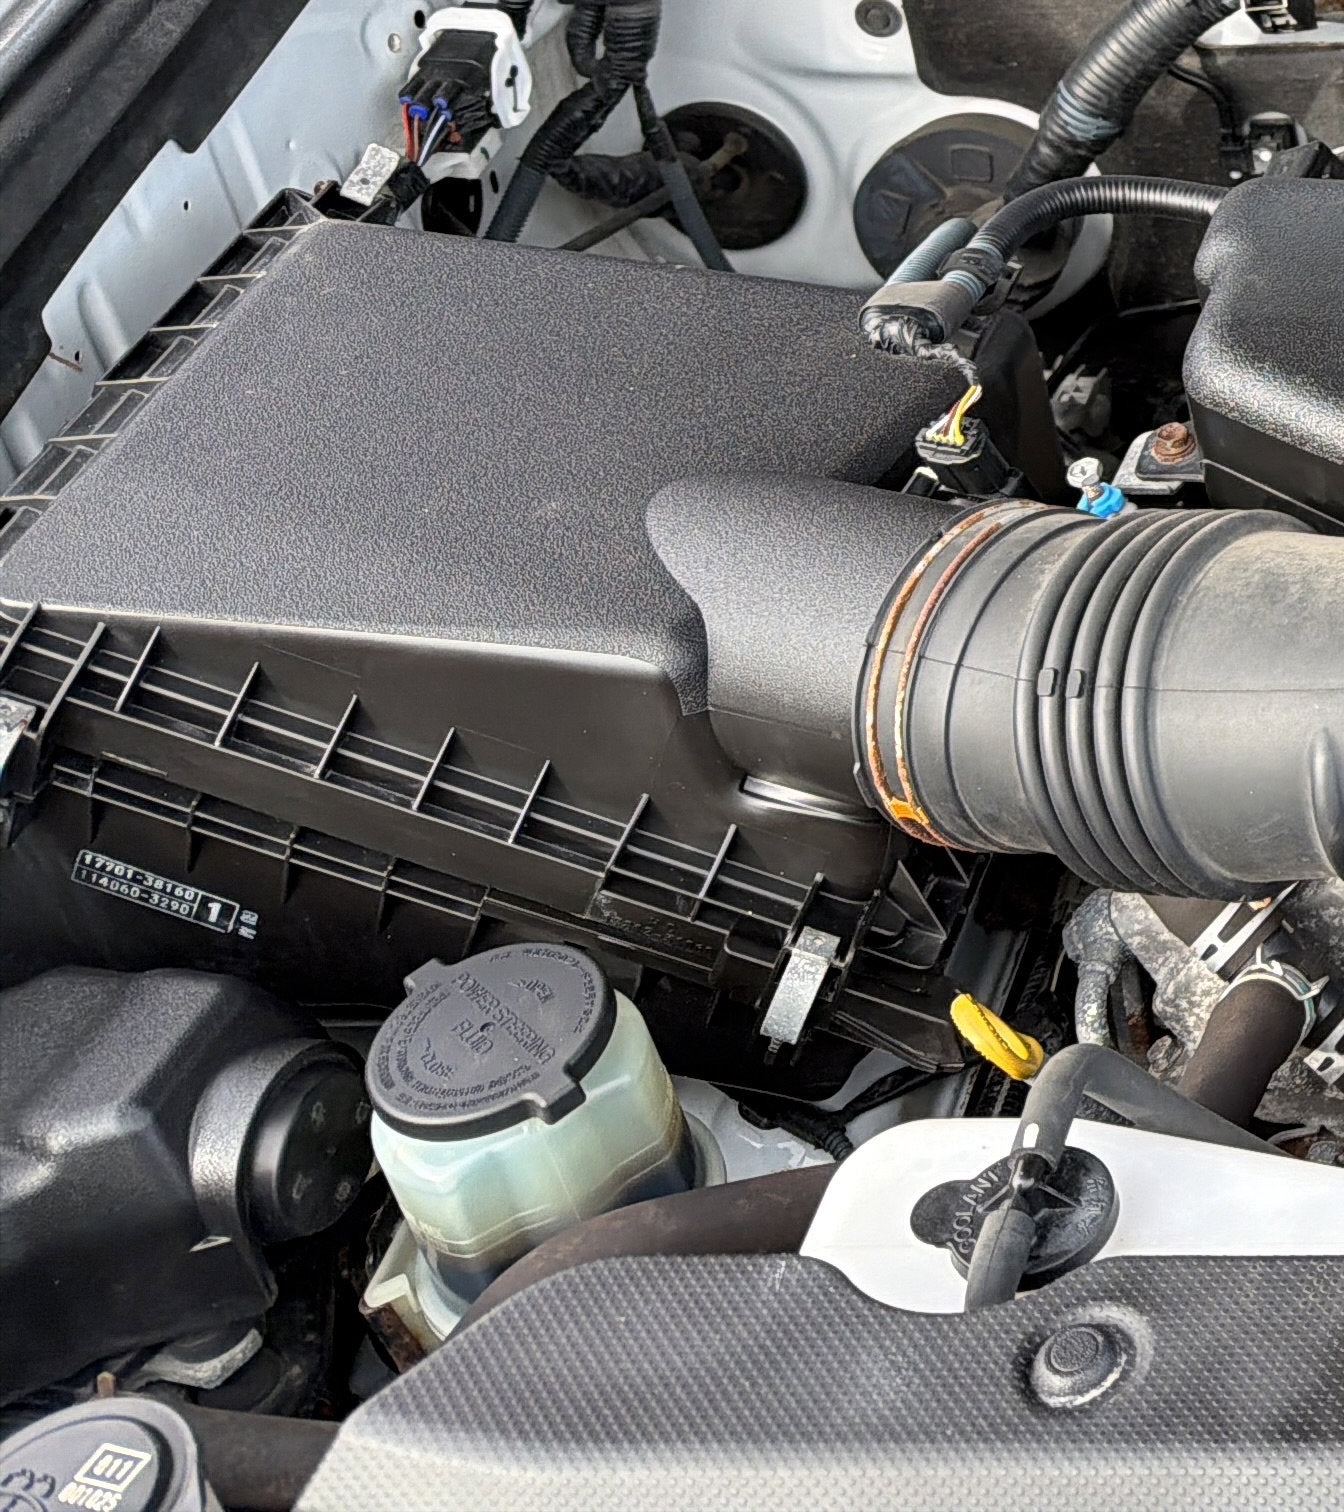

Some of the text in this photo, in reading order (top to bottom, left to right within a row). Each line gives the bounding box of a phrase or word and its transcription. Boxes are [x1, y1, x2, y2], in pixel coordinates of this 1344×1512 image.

[80, 868, 191, 916] 114060-3290
[83, 853, 196, 902] 17701-38160
[206, 901, 222, 924] 1
[451, 970, 501, 1016] POWER
[492, 1006, 557, 1066] STEERING
[451, 1017, 494, 1056] FLUID
[953, 1169, 1000, 1255] COOLANT
